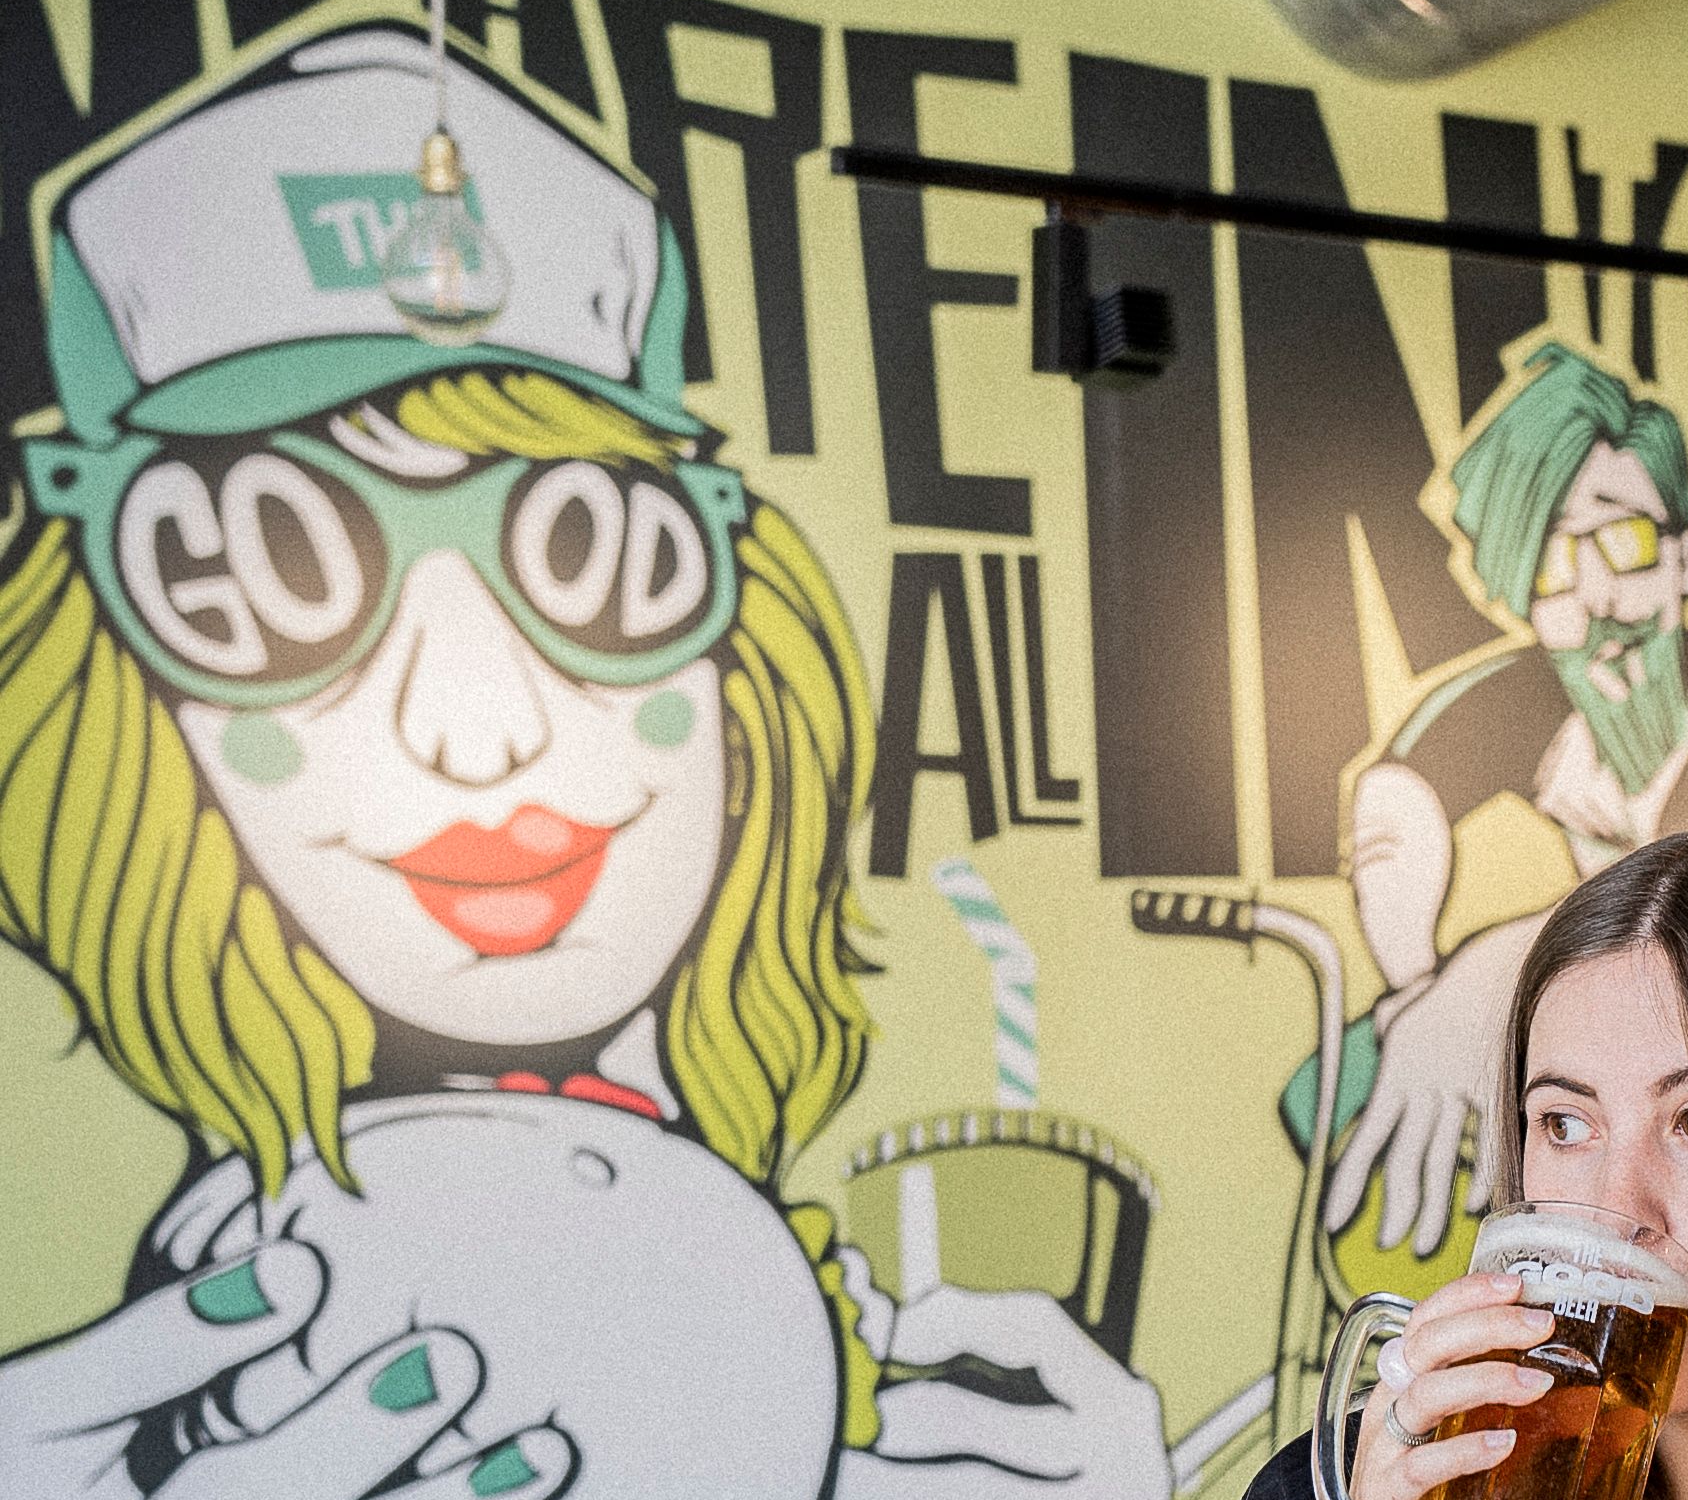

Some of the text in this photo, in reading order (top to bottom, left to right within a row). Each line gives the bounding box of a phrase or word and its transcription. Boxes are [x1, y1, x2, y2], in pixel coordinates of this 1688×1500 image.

[1068, 49, 1550, 878] IN
[868, 550, 1084, 878] ALL
[1506, 1260, 1655, 1315] GOOD
[1553, 1293, 1599, 1324] BEER
